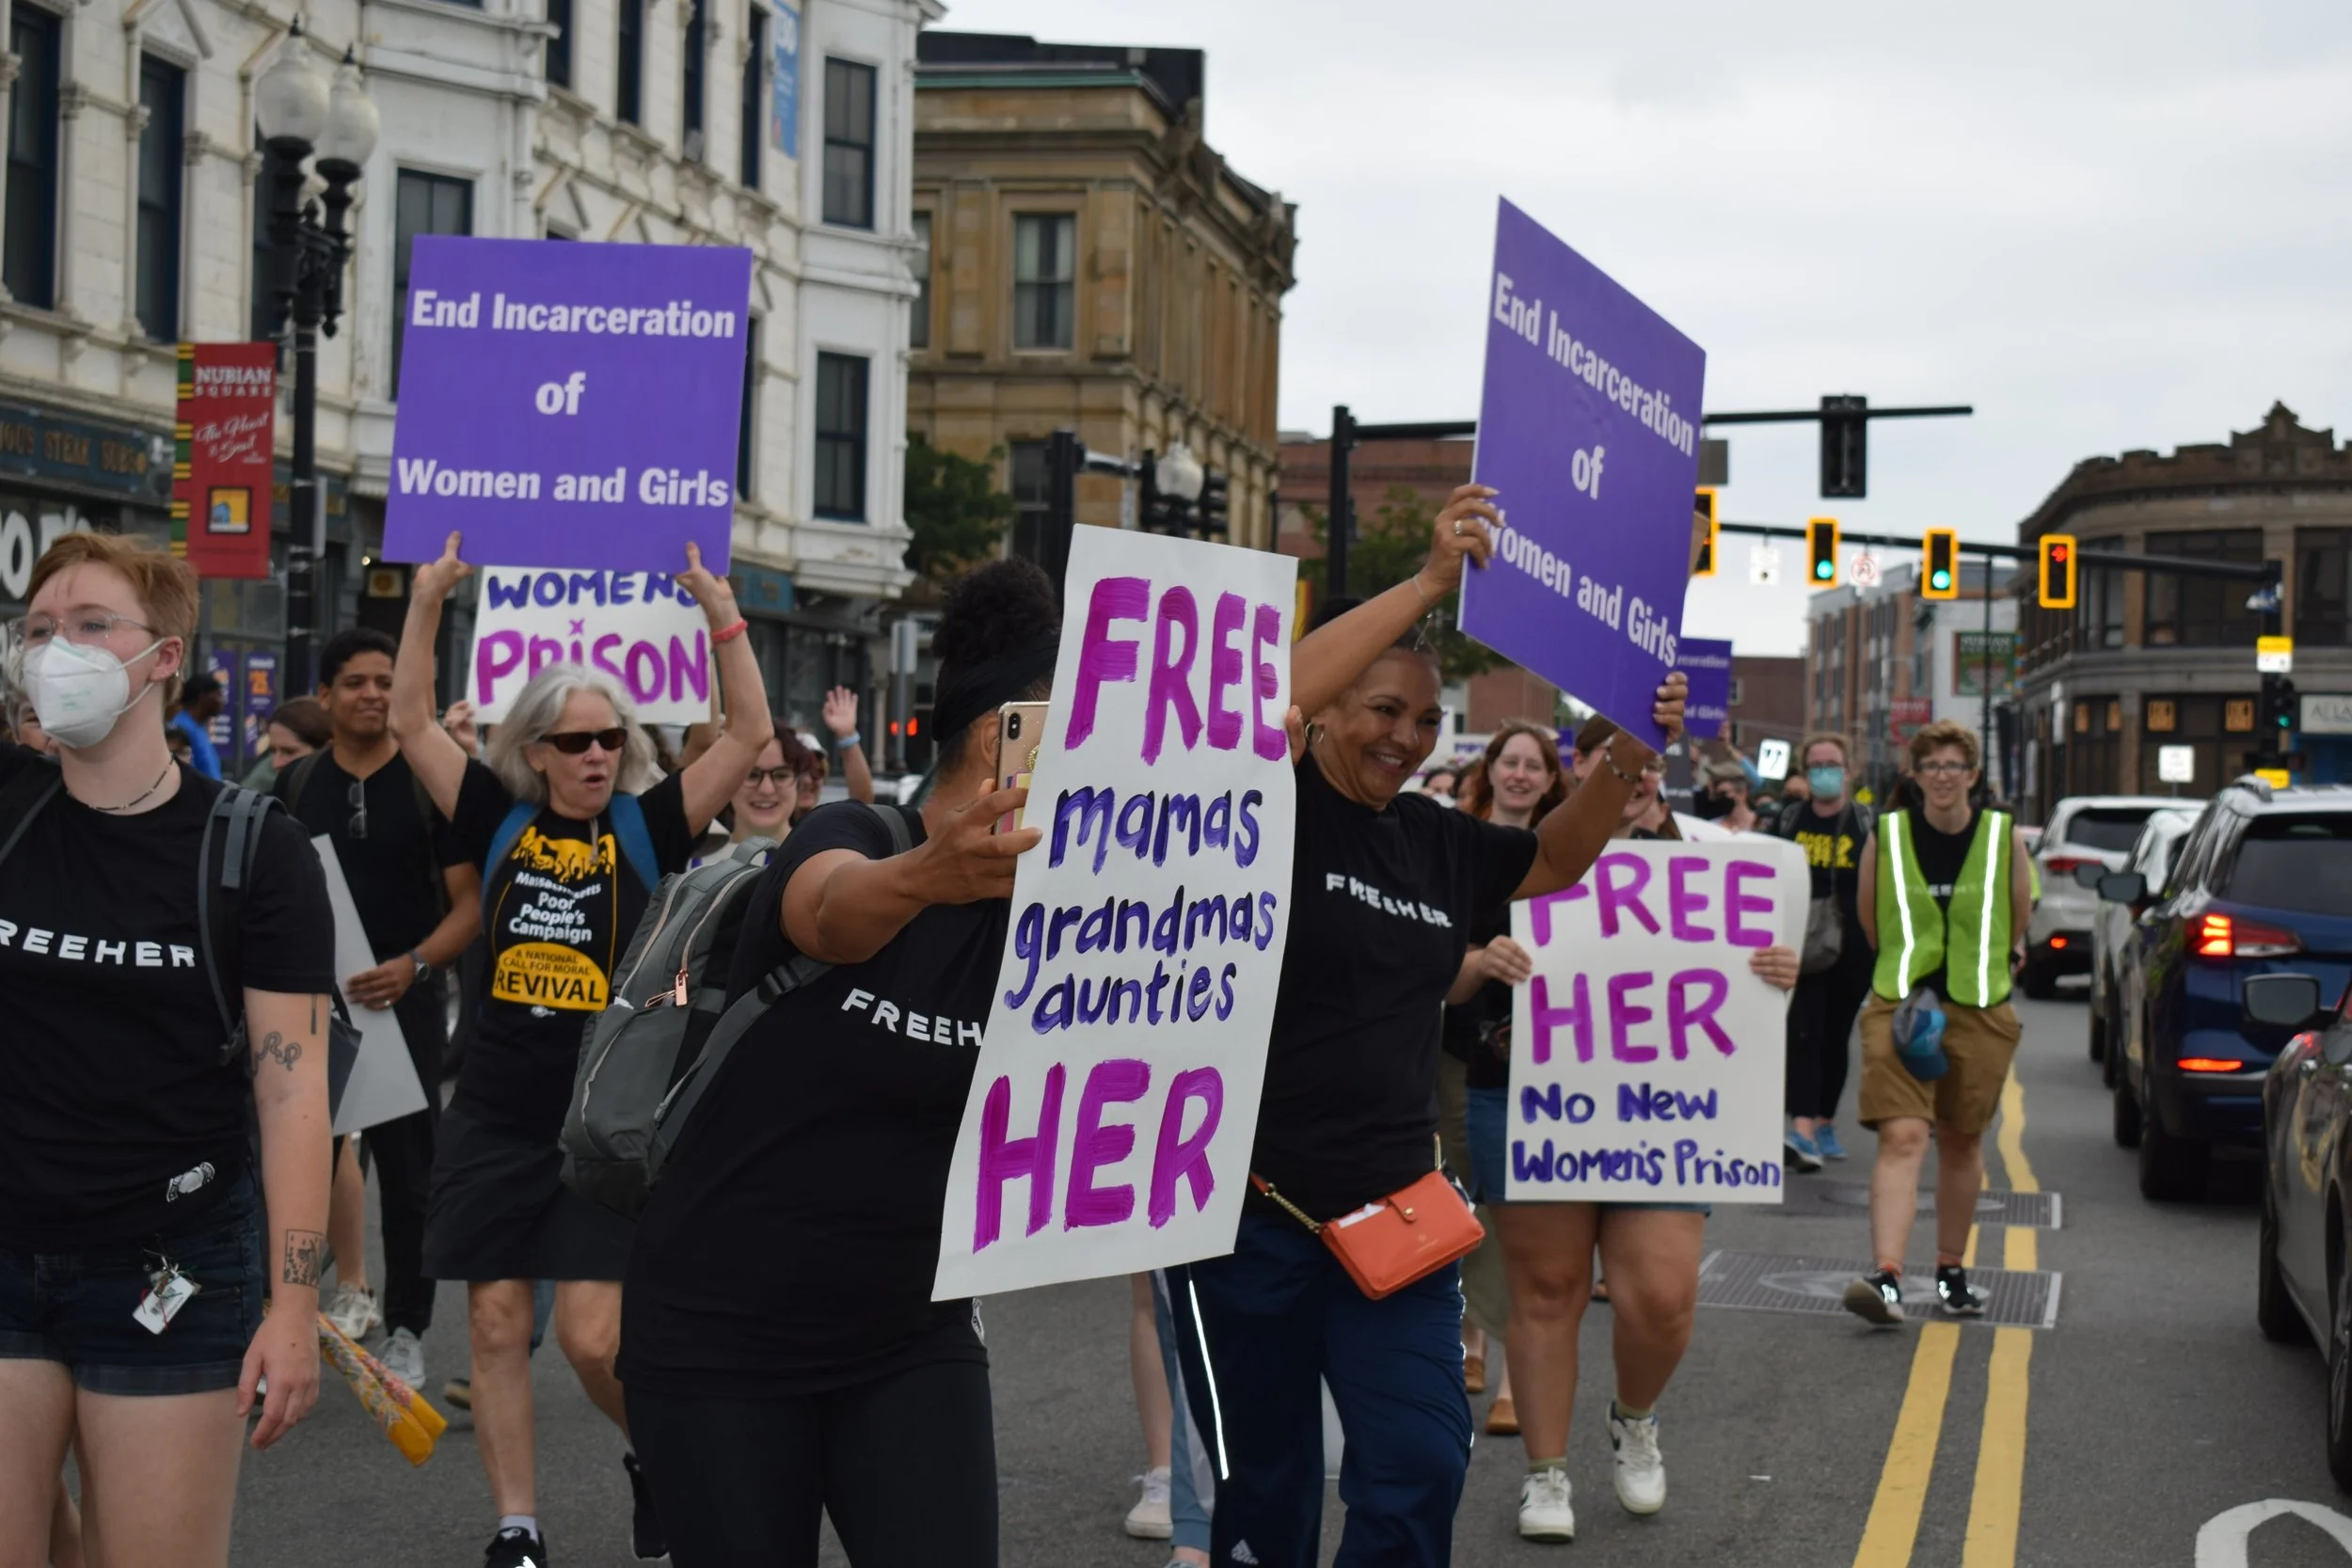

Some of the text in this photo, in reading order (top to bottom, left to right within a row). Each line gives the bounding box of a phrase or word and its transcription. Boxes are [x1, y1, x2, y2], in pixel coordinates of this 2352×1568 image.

[412, 290, 736, 338] End Incarceration
[196, 366, 271, 384] NUBIAN
[1494, 273, 1694, 457] End Incarceration
[195, 384, 271, 397] SQUARE
[535, 372, 586, 415] of
[398, 458, 729, 507] Women and Girls
[1571, 446, 1604, 499] of
[1578, 571, 1620, 631] and
[1627, 596, 1678, 669] Girls
[1064, 576, 1288, 767] FREE
[1048, 785, 1263, 876] mamas
[519, 903, 585, 926] People's
[537, 892, 576, 911] Poor
[1326, 872, 1453, 928] FREEHER
[509, 917, 593, 944] Campaign
[1004, 885, 1277, 1009] grandmas
[503, 958, 591, 975] CALL FOR MORAL
[525, 950, 579, 964] NATIONAL
[495, 967, 602, 1003] REVIVAL
[1032, 959, 1236, 1035] aunties
[1531, 967, 1737, 1065] HER
[1519, 1083, 1718, 1123] No New
[973, 1058, 1223, 1255] HER
[1674, 1139, 1780, 1187] Prison
